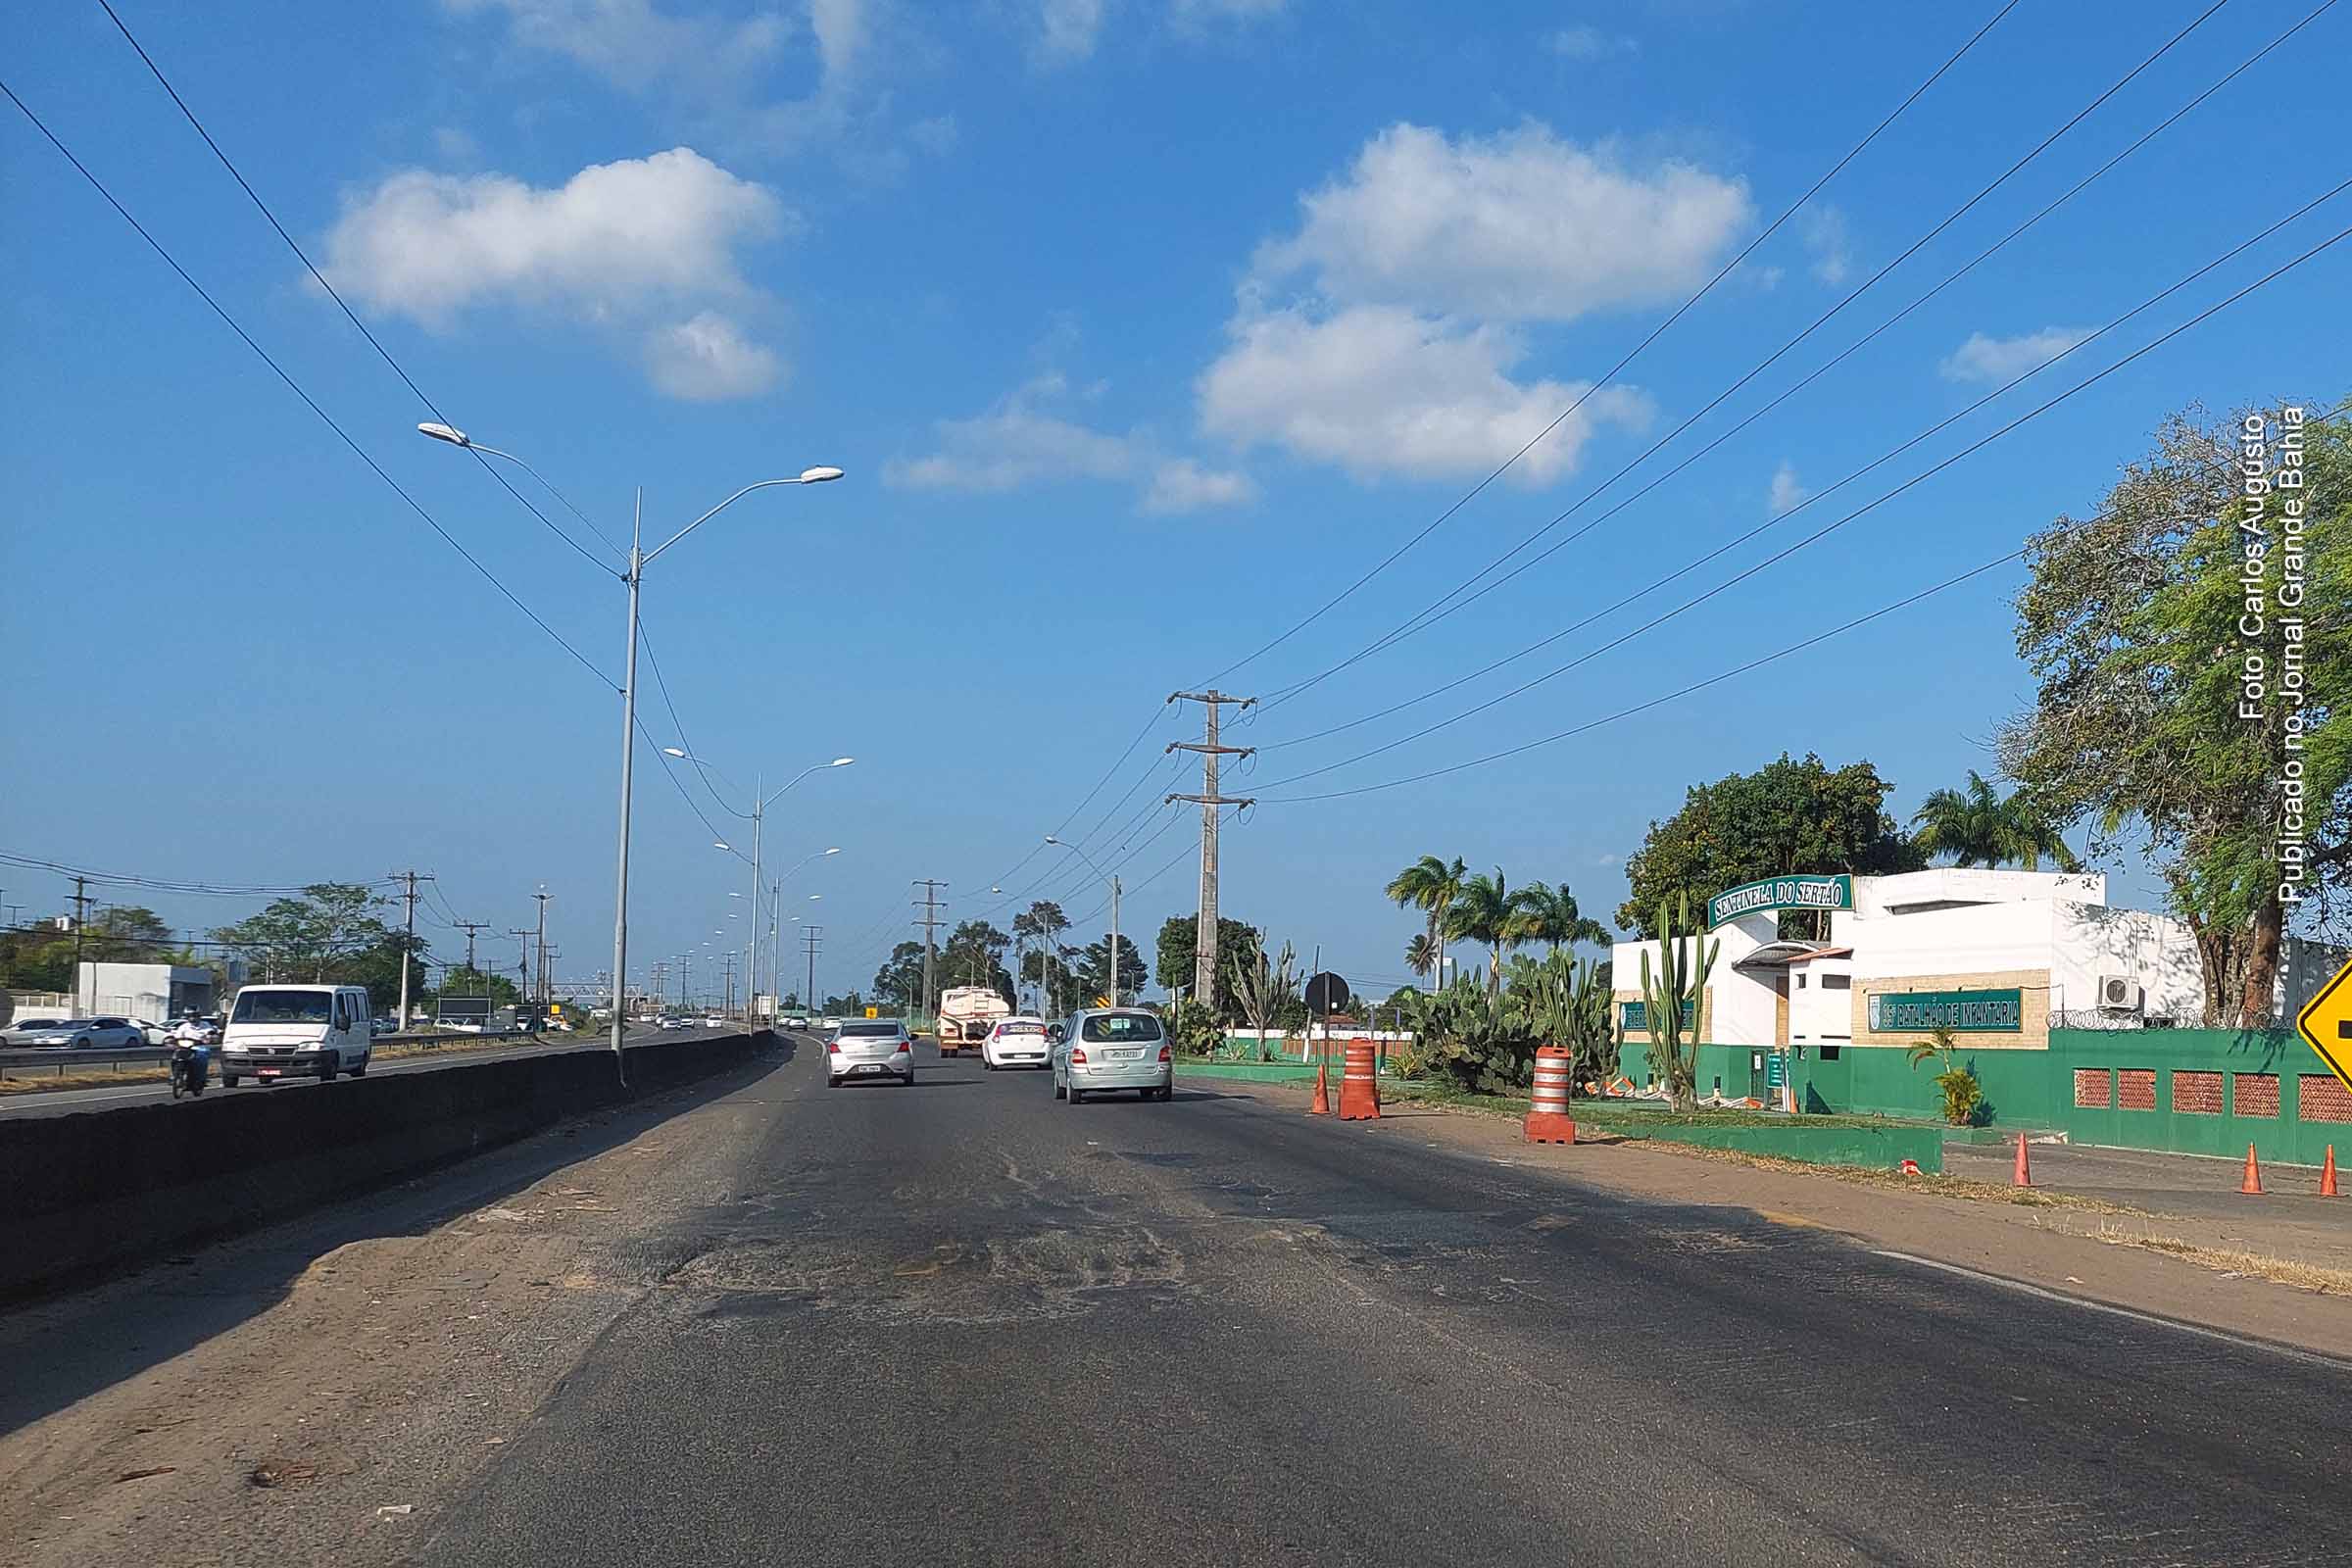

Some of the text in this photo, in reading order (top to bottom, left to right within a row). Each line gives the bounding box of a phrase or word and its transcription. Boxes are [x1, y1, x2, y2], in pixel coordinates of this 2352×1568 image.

[1715, 878, 1842, 921] SENTINELA DO SERTÃO
[1946, 1003, 1959, 1026] DE
[1960, 1001, 2019, 1026] INFANTARIA
